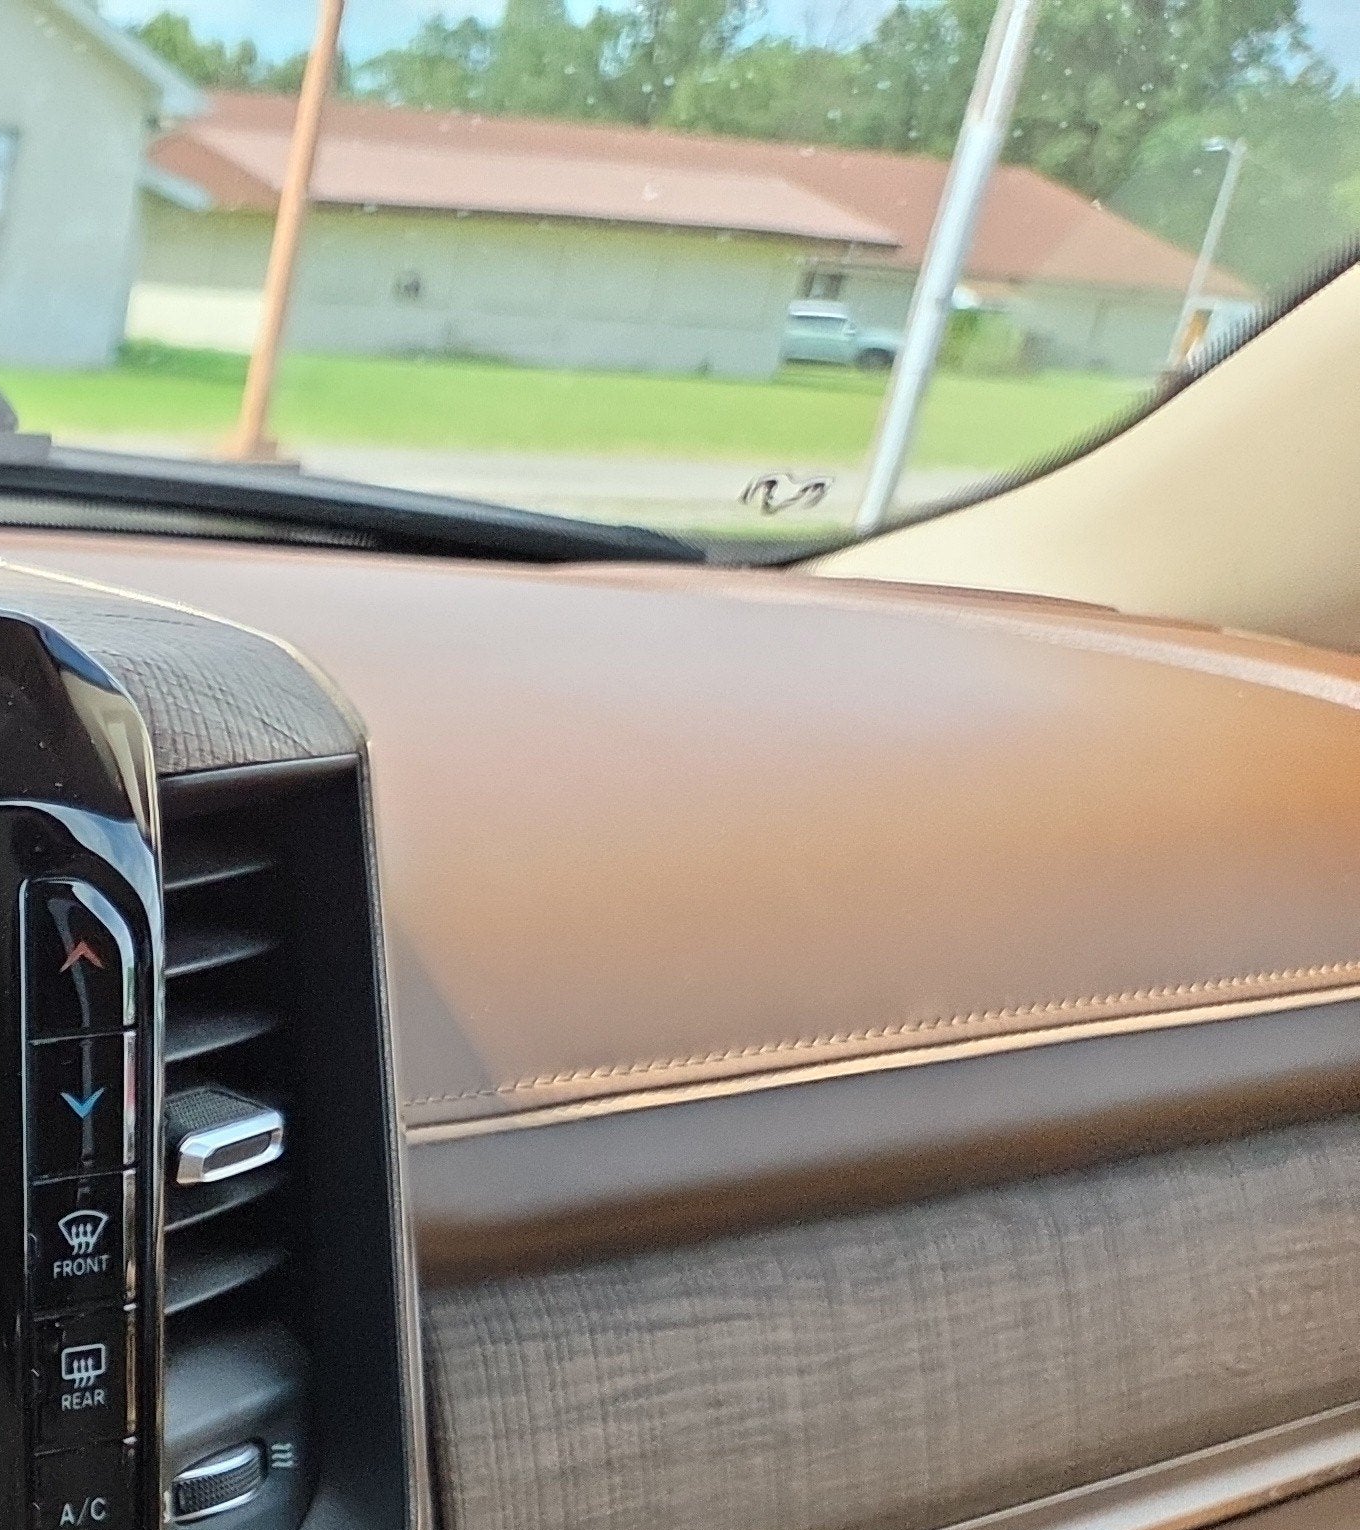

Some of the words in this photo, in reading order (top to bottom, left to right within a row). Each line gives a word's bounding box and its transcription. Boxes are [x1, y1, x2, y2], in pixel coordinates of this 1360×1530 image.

[53, 1255, 111, 1279] FRONT
[61, 1388, 106, 1411] REAR
[60, 1497, 107, 1526] A/C
